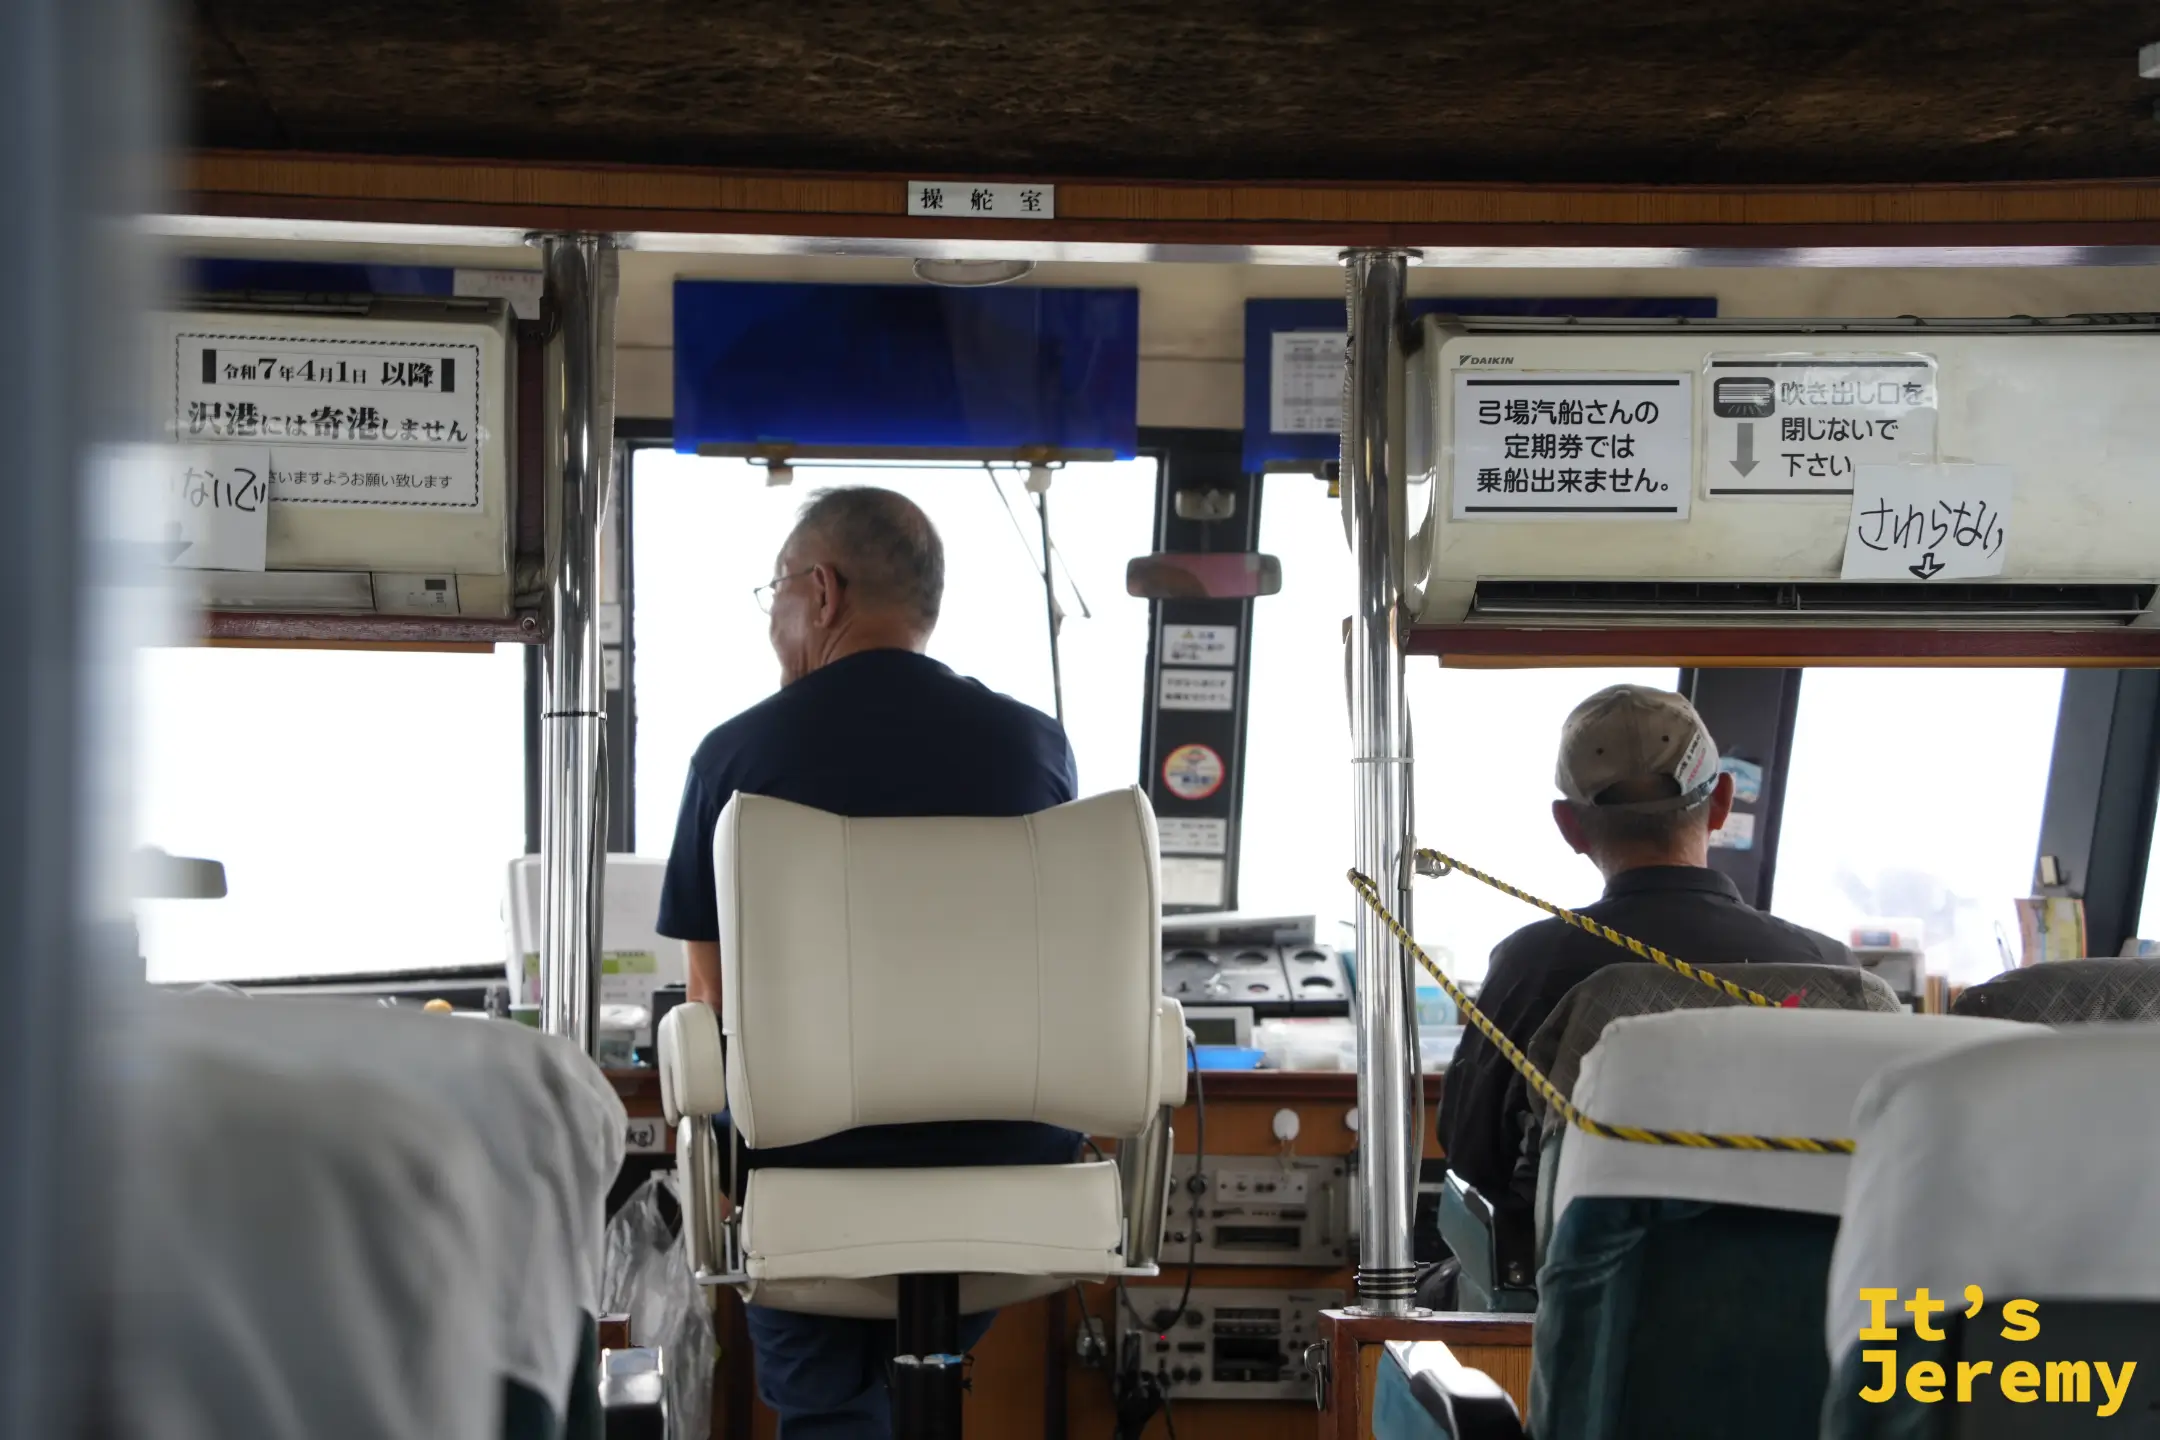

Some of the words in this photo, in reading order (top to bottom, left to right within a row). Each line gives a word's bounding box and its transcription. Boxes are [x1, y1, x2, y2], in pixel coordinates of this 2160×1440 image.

[223, 357, 367, 385] 令和7年4月1日
[380, 360, 435, 388] 以降
[1470, 356, 1515, 365] DAIKIN
[1780, 381, 1925, 407] 吹き出し口を
[187, 400, 468, 443] 沢港には寄港しません
[1478, 399, 1660, 425] 弓場汽船さんの
[1780, 416, 1899, 442] 閉じないで
[1503, 433, 1635, 459] 定期券では
[1476, 467, 1670, 493] 乗船出来ません。
